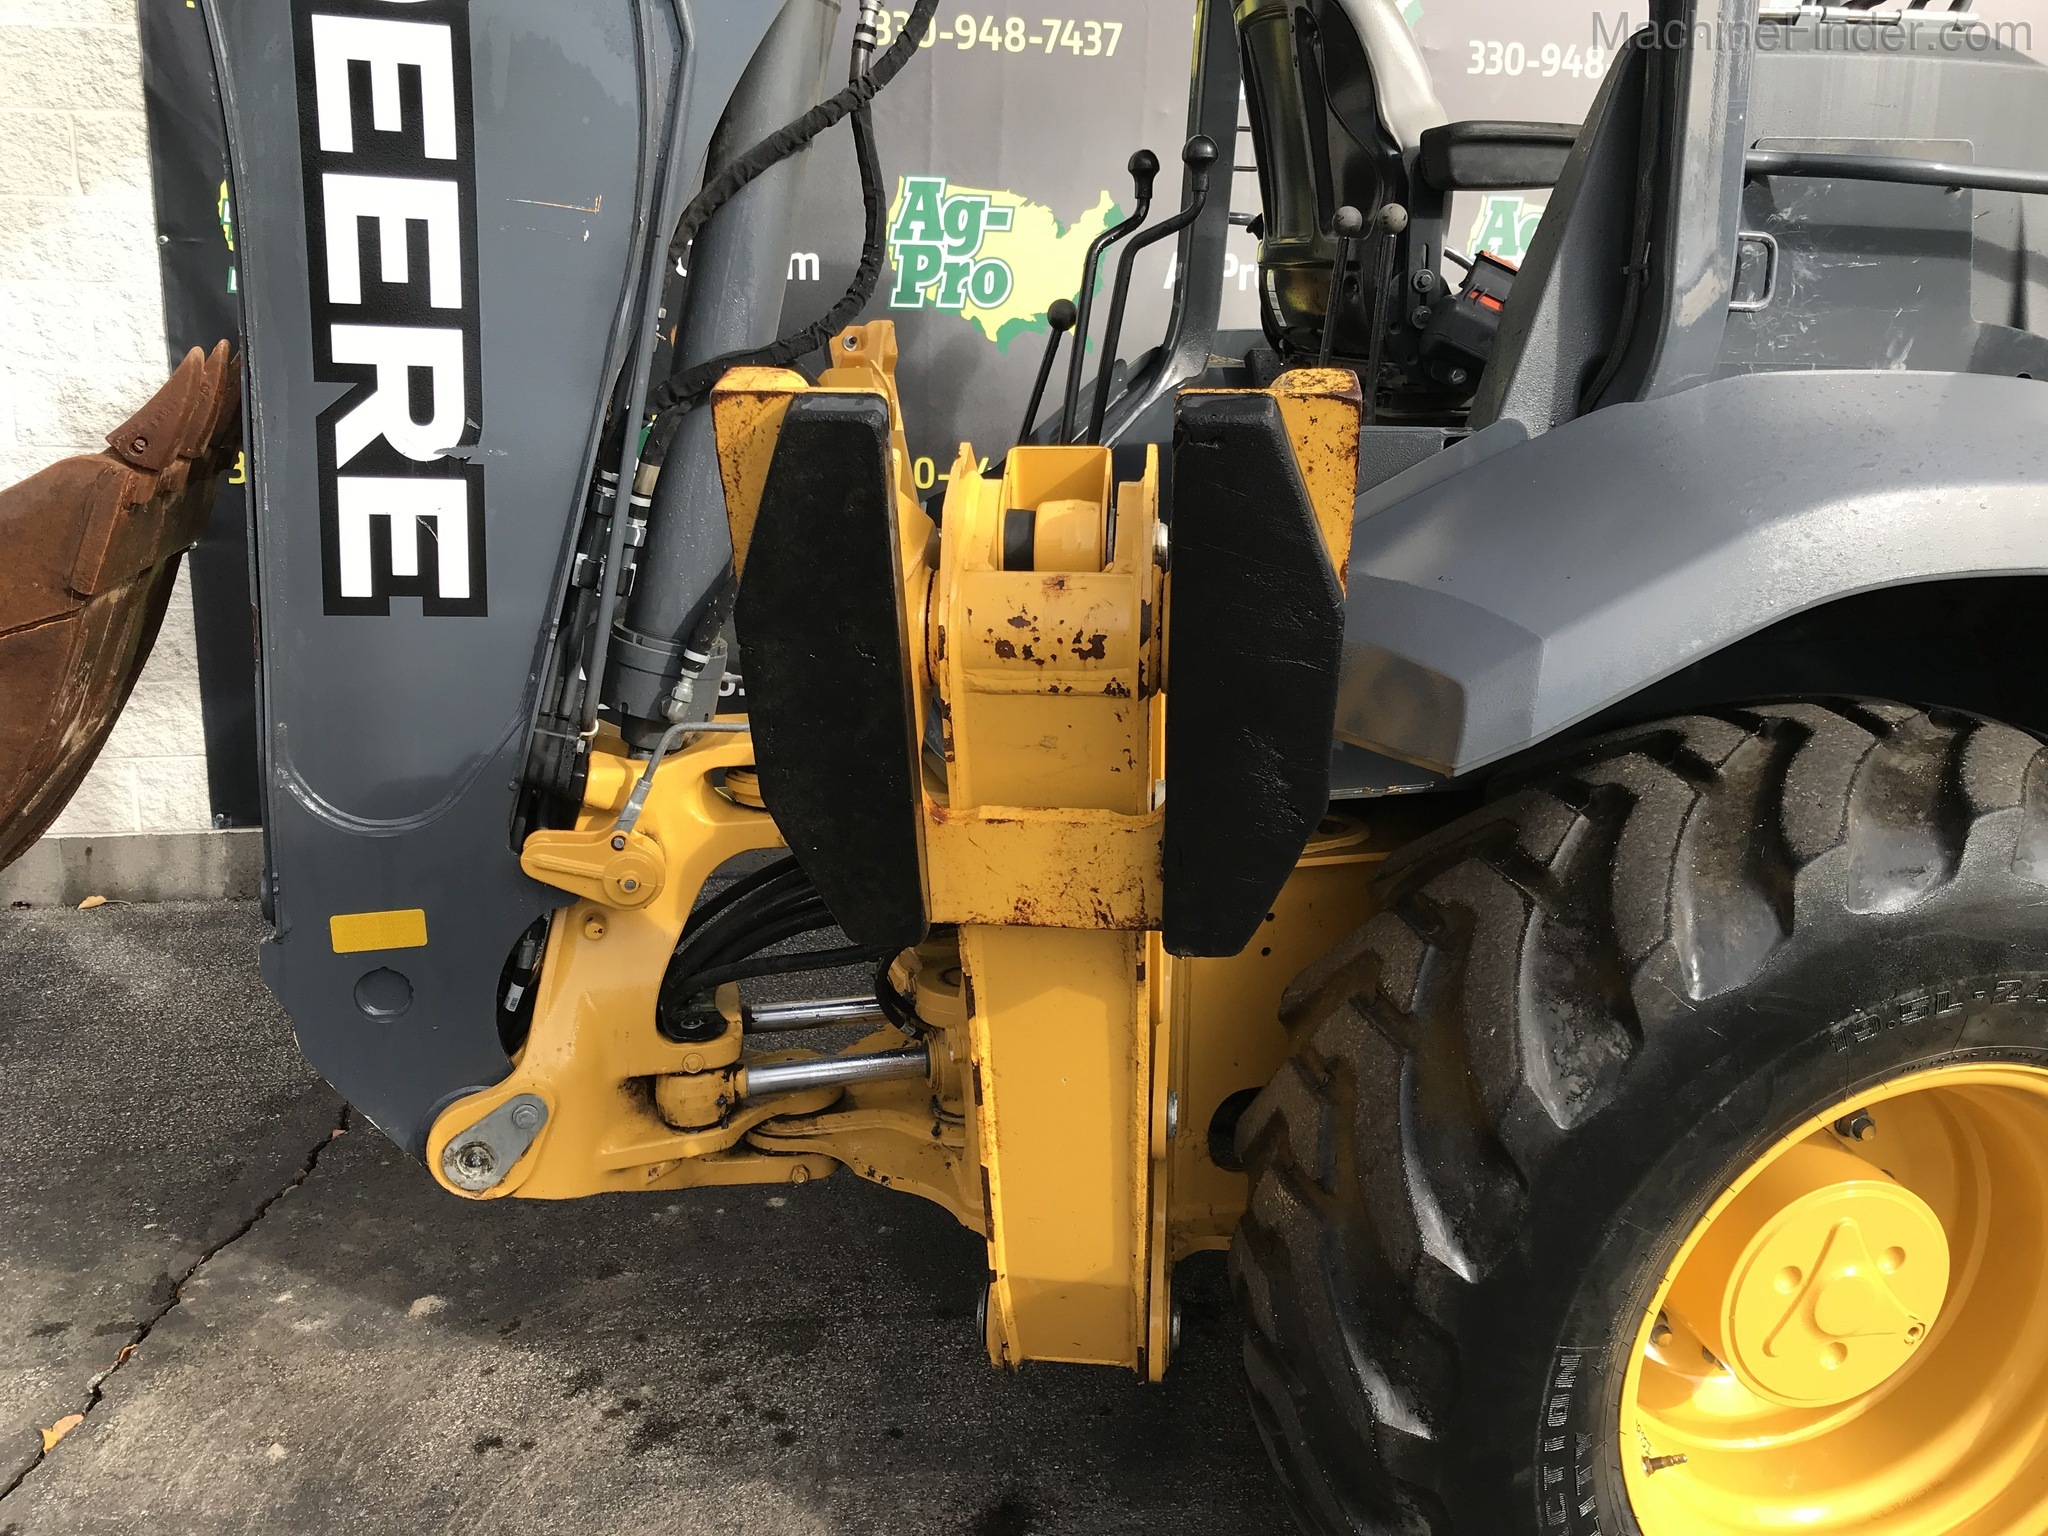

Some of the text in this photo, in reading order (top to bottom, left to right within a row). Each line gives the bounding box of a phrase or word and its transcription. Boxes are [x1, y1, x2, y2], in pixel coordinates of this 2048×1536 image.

[889, 176, 1015, 260] Ag-
[311, 0, 470, 598] EERE
[890, 244, 1013, 308] Pro
